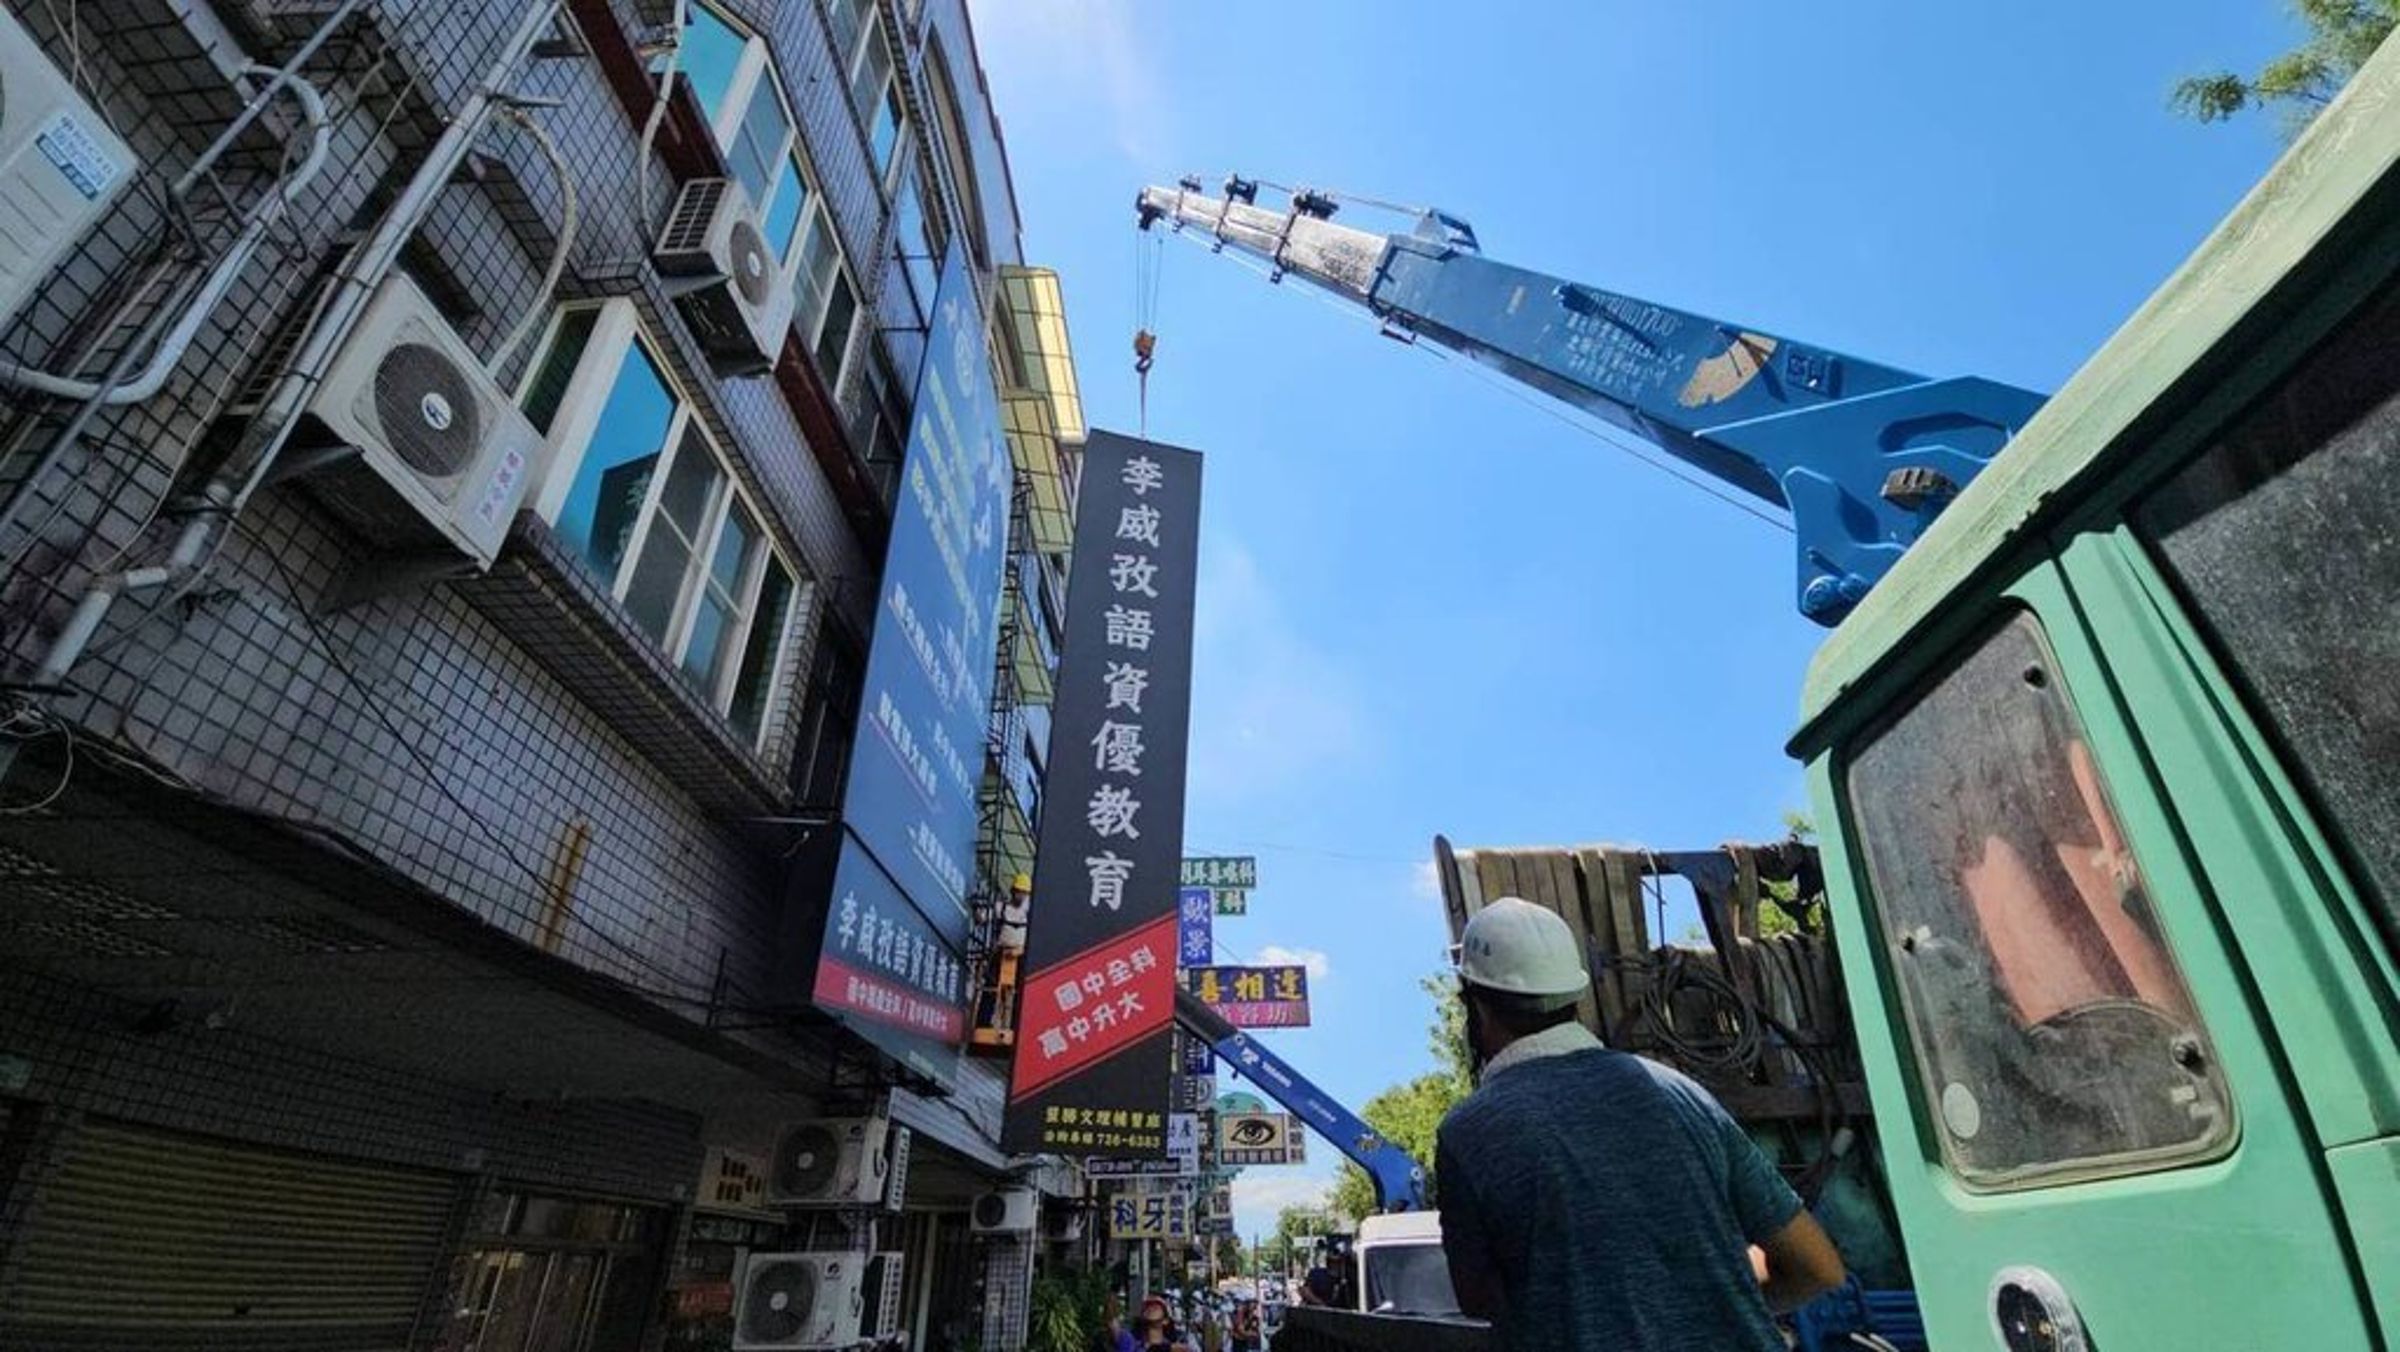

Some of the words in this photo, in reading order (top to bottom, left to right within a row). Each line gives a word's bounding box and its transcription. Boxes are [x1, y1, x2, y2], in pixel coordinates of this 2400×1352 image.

[1085, 455, 1163, 912] 李威孜語資優教育
[1054, 945, 1156, 1013] 國中全科
[1037, 990, 1145, 1060] 高中升大
